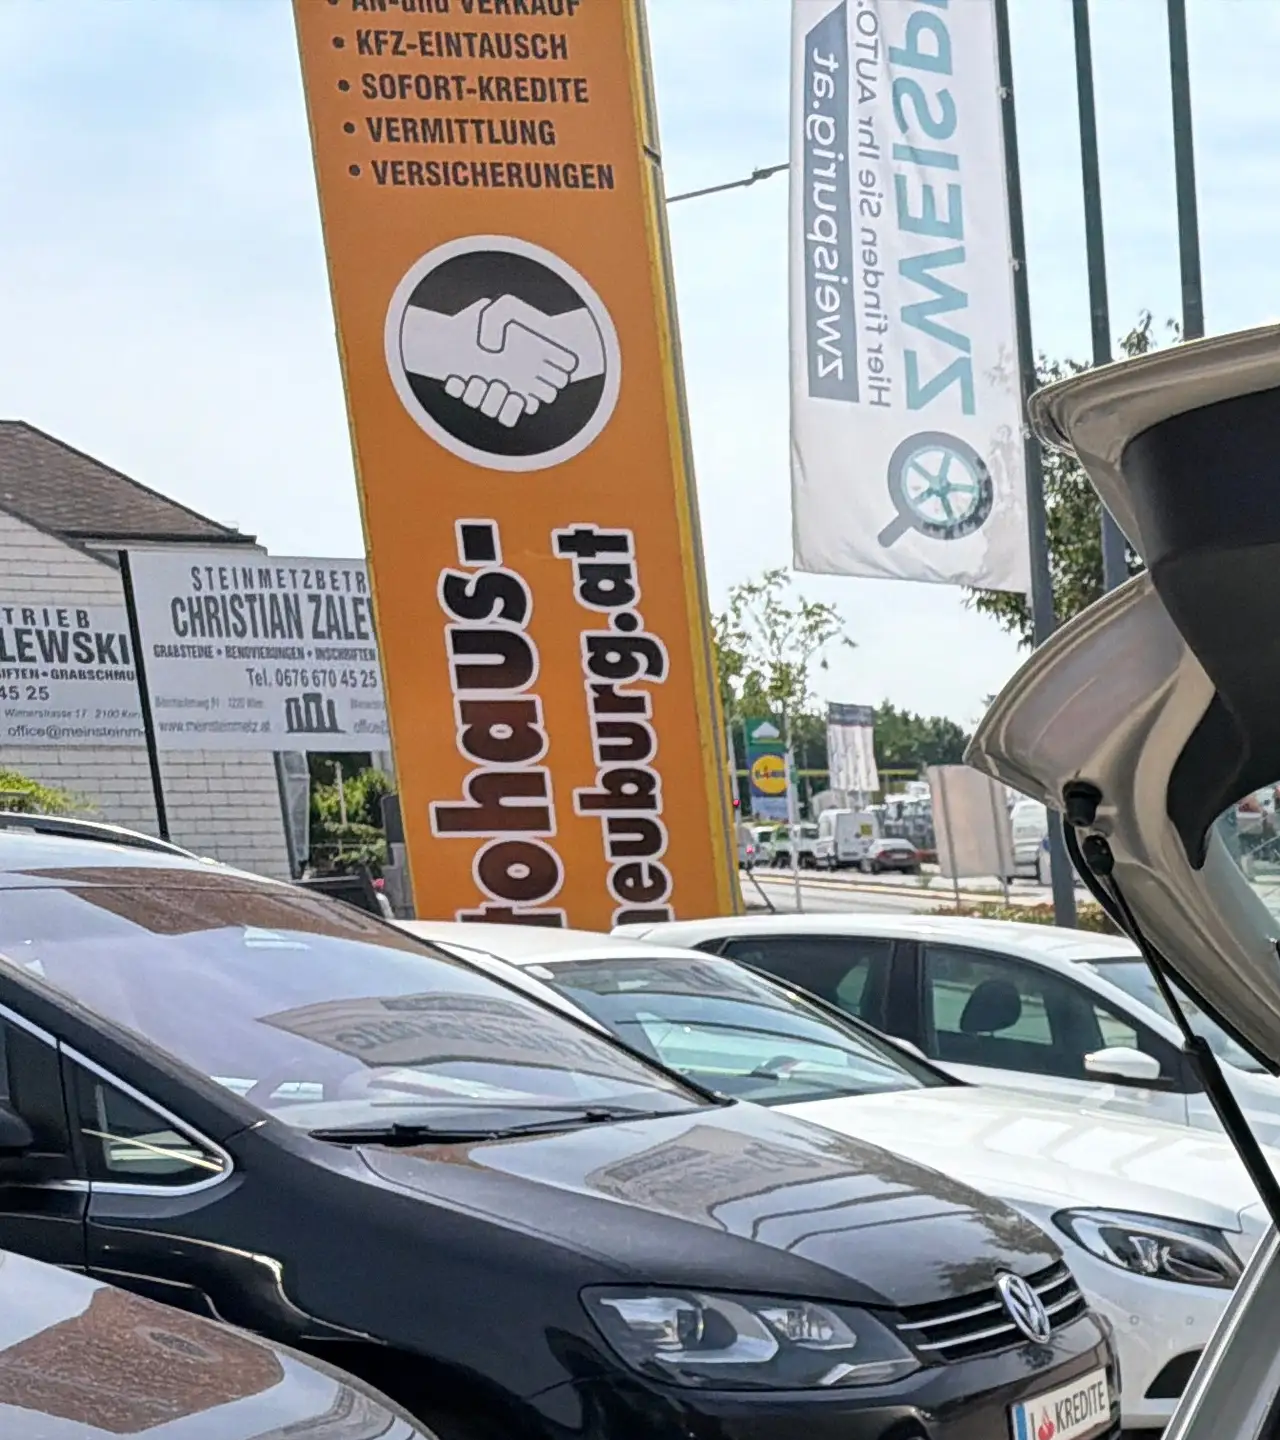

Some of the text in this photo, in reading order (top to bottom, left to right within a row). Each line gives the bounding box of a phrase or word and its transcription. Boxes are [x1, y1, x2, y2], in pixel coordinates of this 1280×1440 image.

[356, 29, 568, 60] KFZ-EINTAUSCH
[361, 73, 589, 103] SOFORT-KREDITE
[366, 117, 556, 146] VERMITTLUNG
[371, 160, 615, 189] VERSICHERUNGEN
[190, 565, 367, 594] STEINMETZBETR
[2, 607, 90, 629] TRIEB
[170, 593, 375, 640] CHRISTIAN ZALE
[0, 627, 130, 665] LEWSKI
[246, 668, 378, 688] Tel. 0676 670 45 25
[26, 685, 50, 701] 25
[1055, 1381, 1106, 1434] KREDITE
